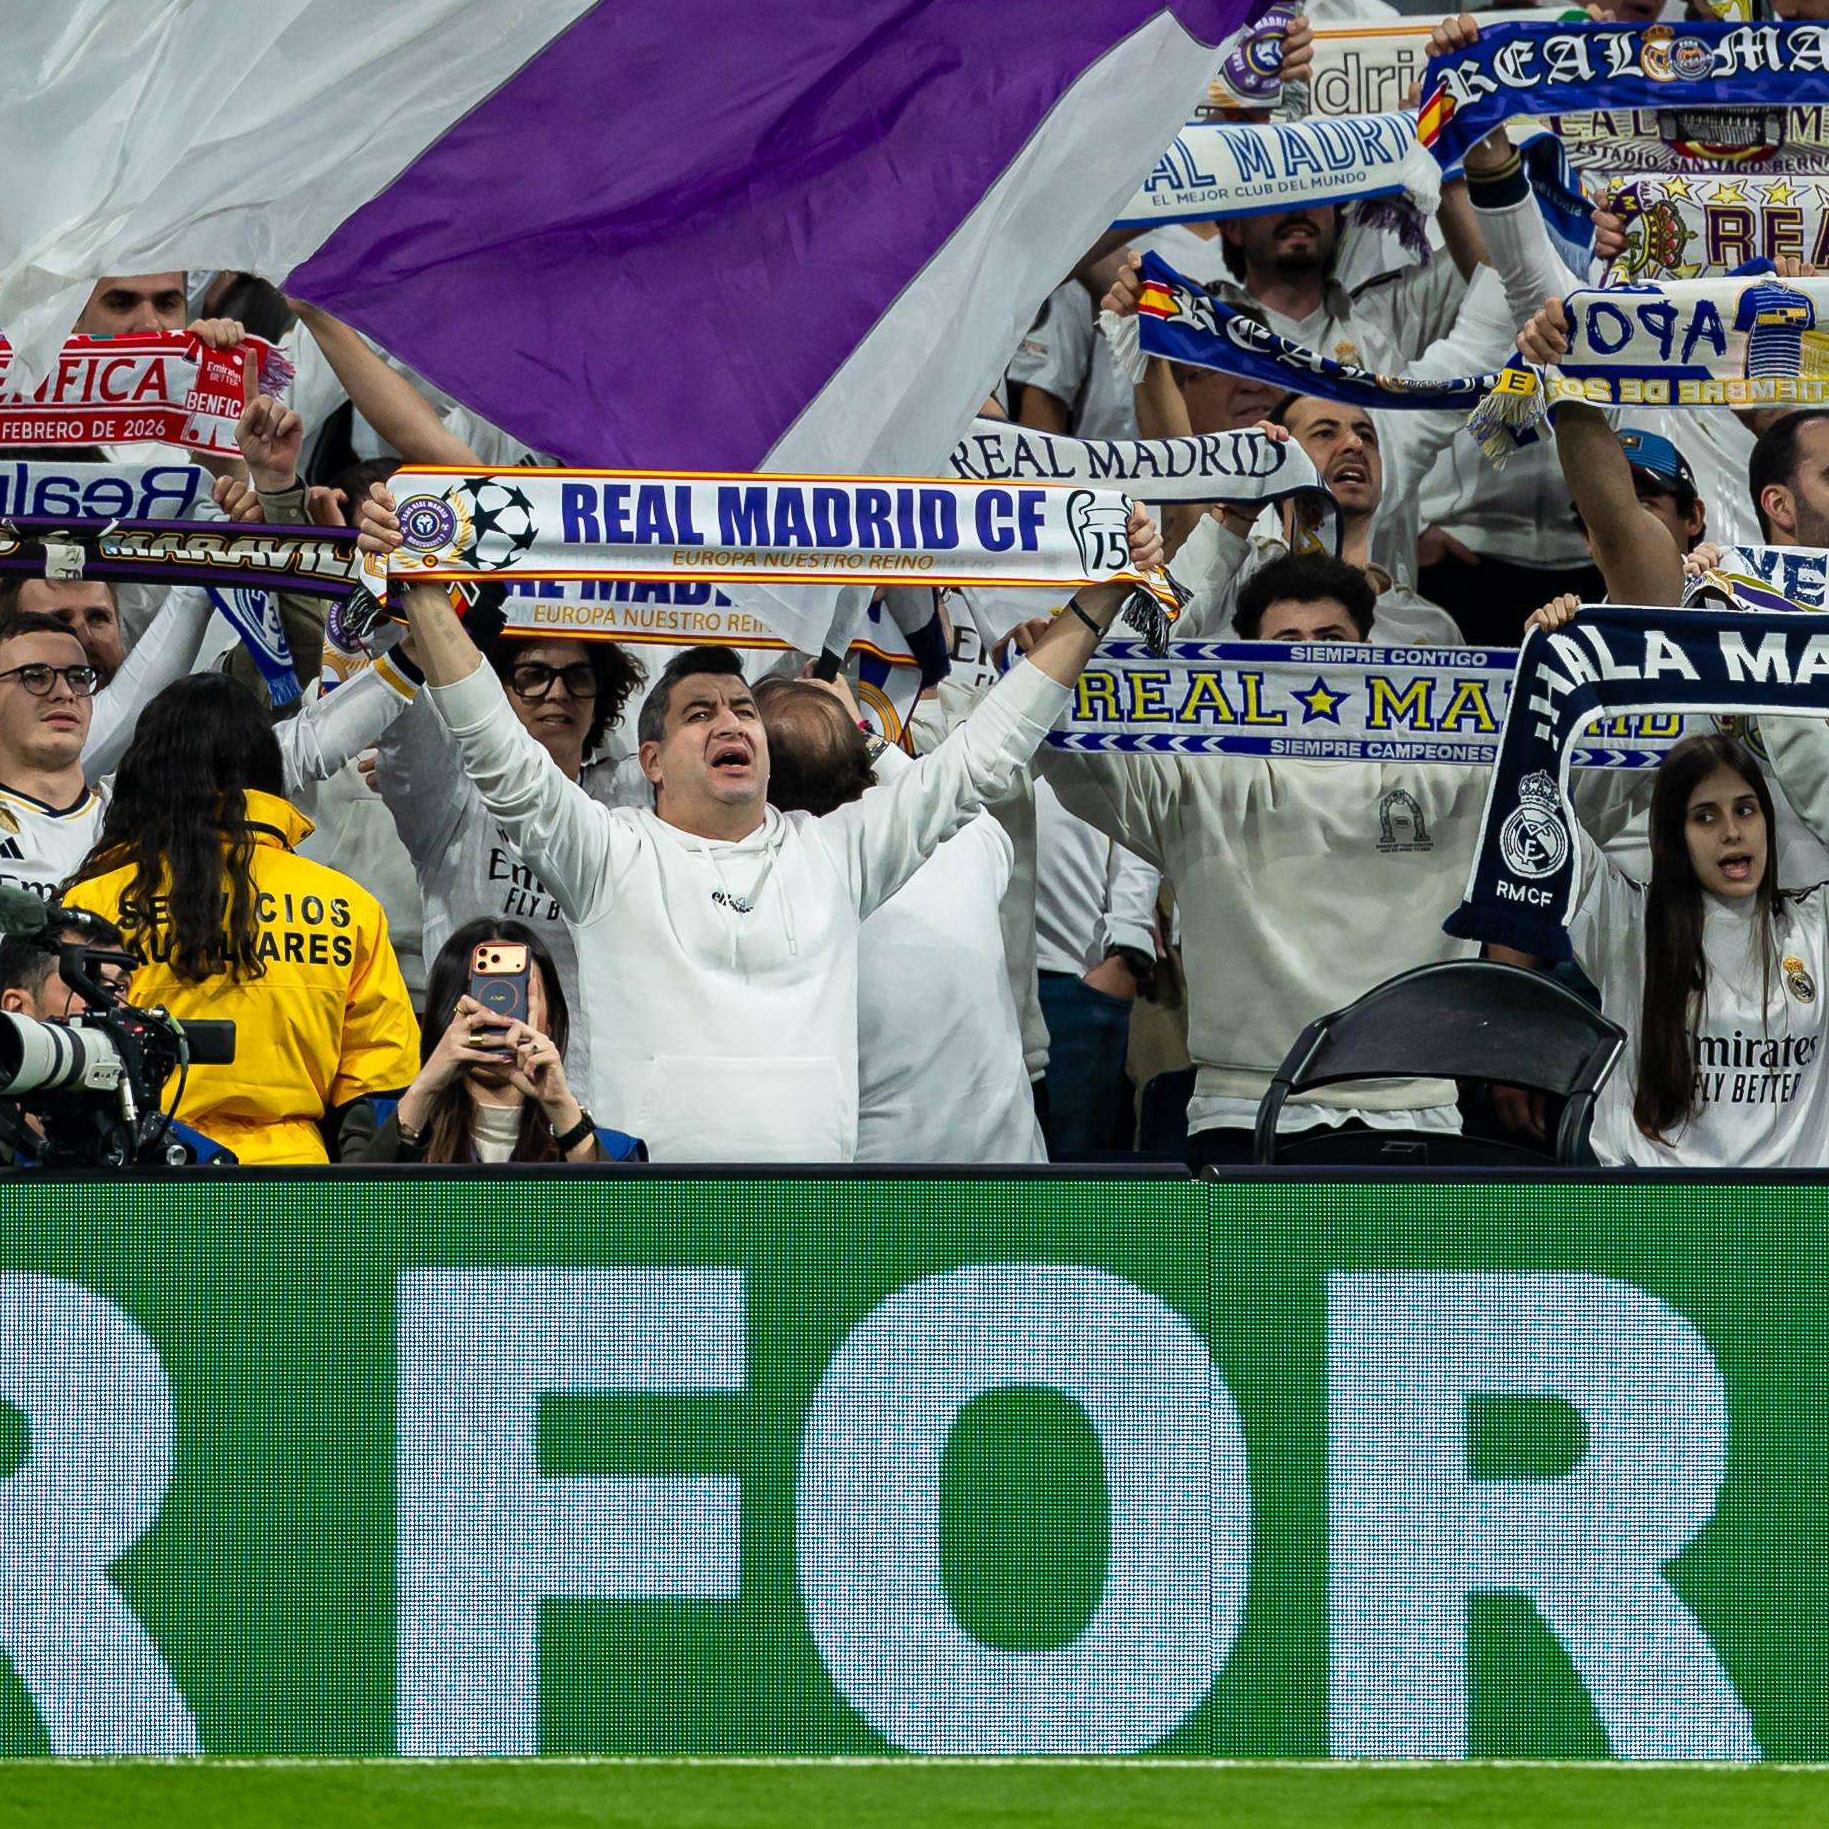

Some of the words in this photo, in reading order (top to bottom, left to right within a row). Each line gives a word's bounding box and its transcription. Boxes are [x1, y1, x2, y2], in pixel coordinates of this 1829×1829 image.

[1440, 28, 1642, 108] REAL
[1174, 188, 1232, 206] MEJOR
[1236, 184, 1273, 200] CLUB
[1277, 179, 1306, 196] DEL
[1309, 172, 1368, 192] MUNDO
[1, 419, 86, 441] FEBRERO
[92, 418, 116, 440] DE
[123, 417, 167, 439] 2026
[952, 434, 1076, 480] REAL
[1088, 436, 1288, 479] MADRID
[560, 481, 705, 547] REAL
[717, 485, 958, 551] MADRID
[974, 487, 1048, 553] CF
[672, 548, 759, 569] EUROPA
[763, 550, 865, 571] NUESTRO
[868, 552, 935, 572] REINO
[1290, 646, 1385, 667] SIEMPRE
[1388, 648, 1489, 669] CONTIGO
[1072, 669, 1288, 727] REAL
[1269, 738, 1361, 759] SIEMPRE
[1365, 740, 1495, 763] CAMPEONES
[1495, 878, 1555, 909] RMCF
[394, 1260, 1762, 1760] FOR
